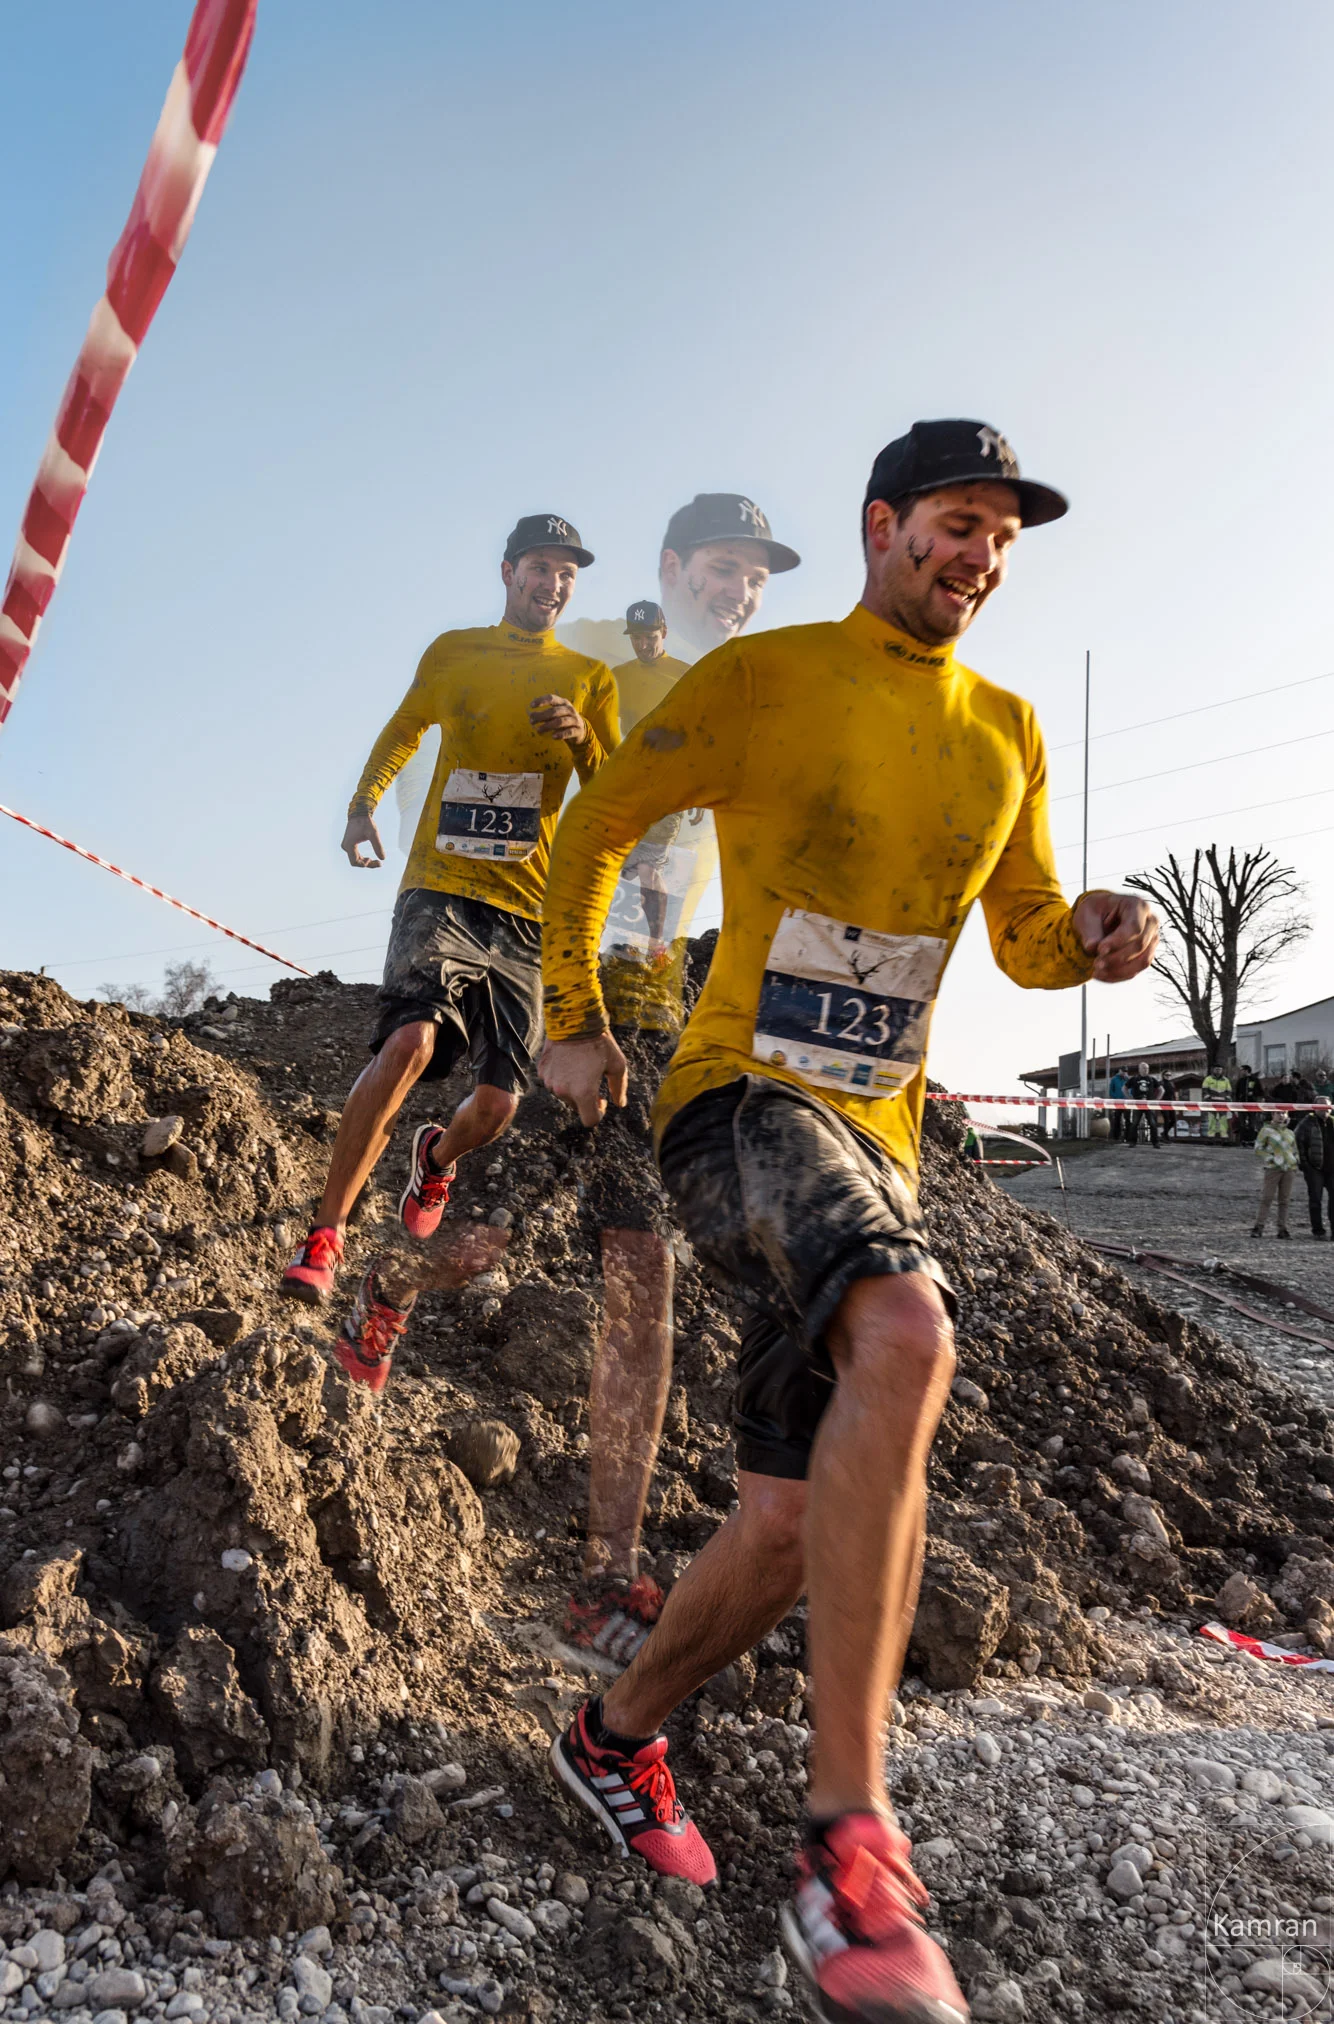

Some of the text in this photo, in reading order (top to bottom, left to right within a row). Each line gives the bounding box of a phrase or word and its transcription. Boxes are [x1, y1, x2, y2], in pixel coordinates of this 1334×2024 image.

[547, 517, 568, 536] NY
[634, 608, 645, 621] NY
[466, 808, 513, 835] 123
[608, 885, 646, 923] 23
[811, 992, 892, 1046] 123
